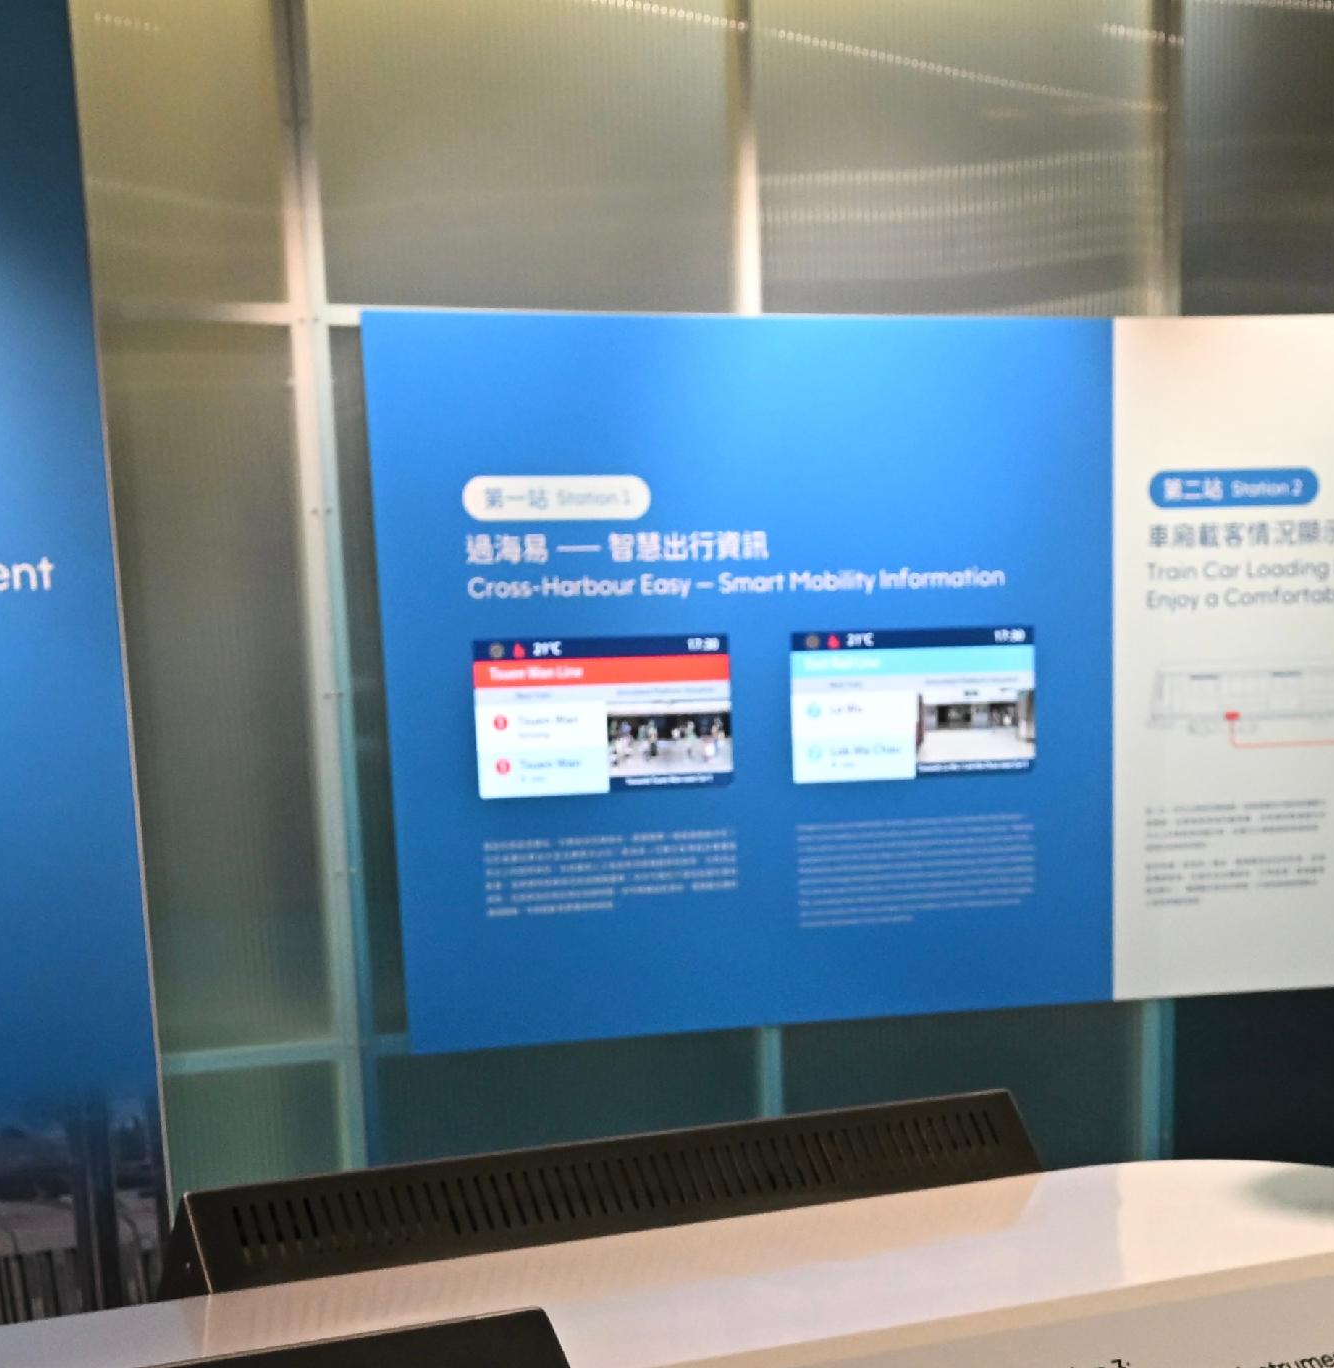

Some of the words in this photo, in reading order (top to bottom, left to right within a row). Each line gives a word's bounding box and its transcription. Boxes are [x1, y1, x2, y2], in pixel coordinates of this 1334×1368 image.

[483, 487, 548, 509] 第一站
[557, 488, 617, 506] Station
[1231, 480, 1289, 497] Station
[607, 531, 767, 562] 智慧出行資訊
[1147, 561, 1197, 581] Train
[1201, 560, 1239, 580] Car
[1245, 559, 1330, 581] Loading
[467, 575, 636, 598] Cross-Harbour
[639, 573, 691, 598] Easy
[718, 572, 784, 594] Smart
[788, 569, 875, 593] Mobility
[878, 566, 1005, 589] Information
[1145, 589, 1199, 611] Enjoy
[1204, 592, 1219, 608] a
